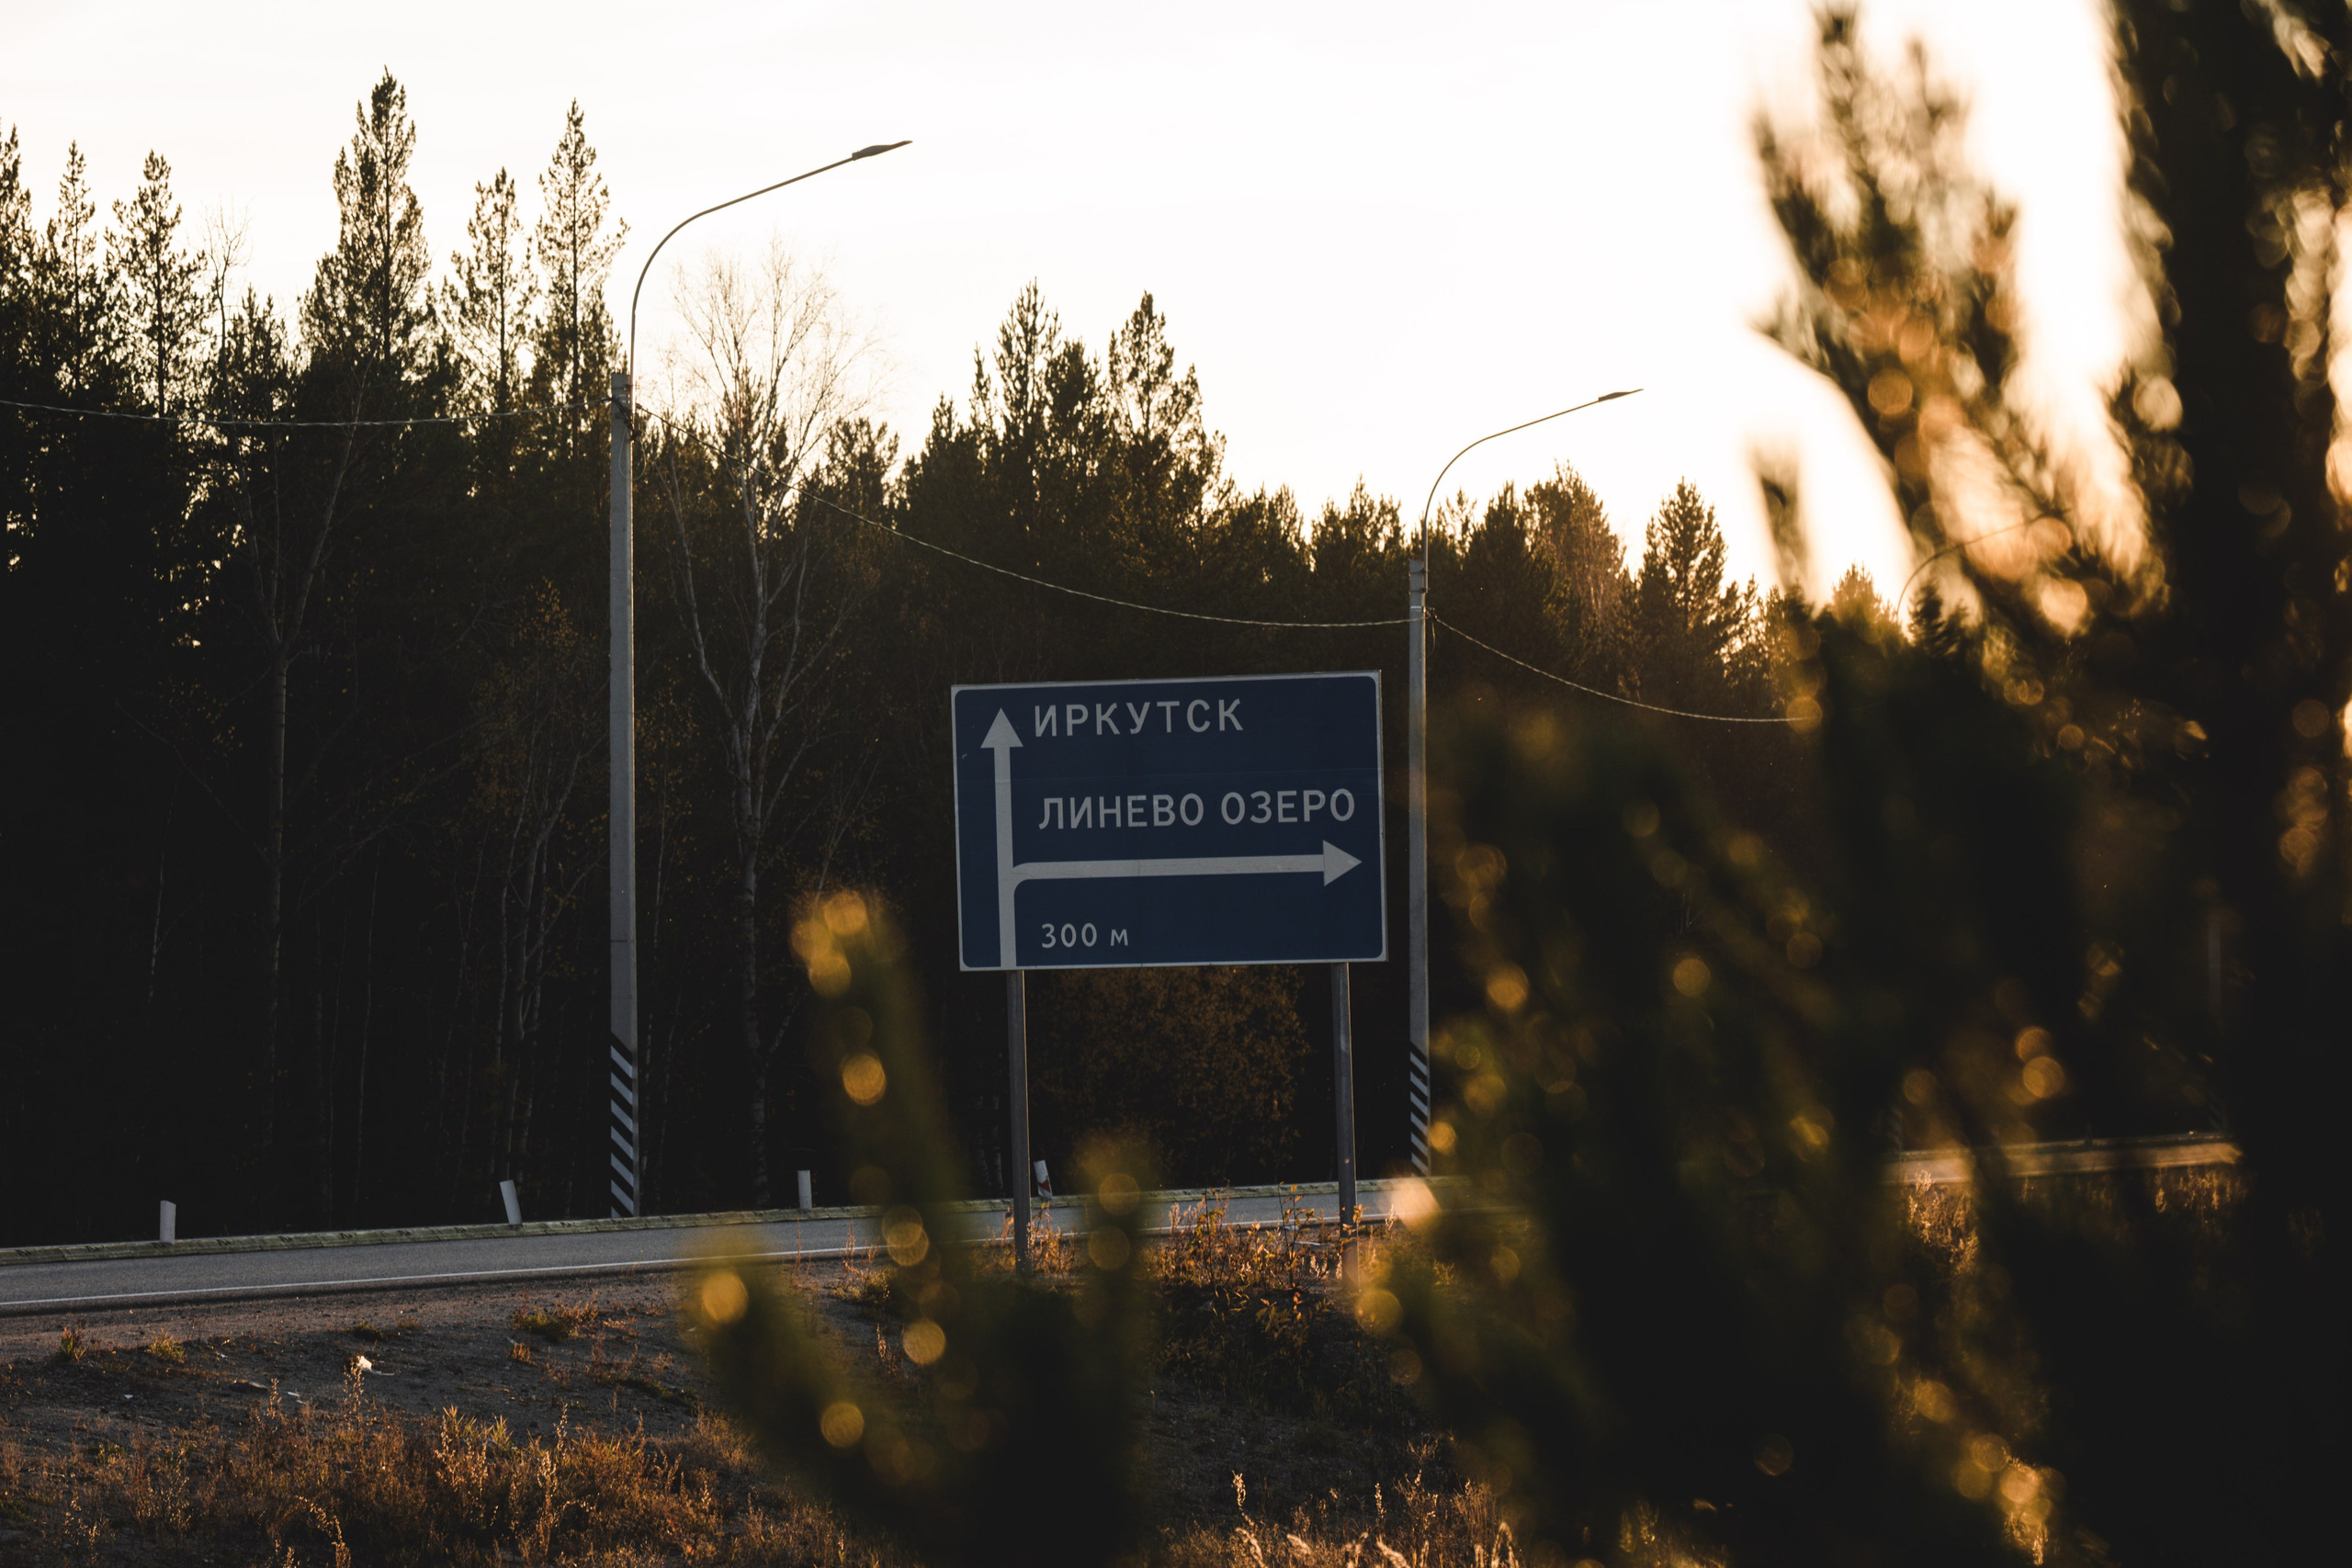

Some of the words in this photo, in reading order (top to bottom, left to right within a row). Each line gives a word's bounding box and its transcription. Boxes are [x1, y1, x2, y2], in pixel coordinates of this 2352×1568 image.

[1035, 698, 1243, 738] ИРКУТСК
[1038, 793, 1204, 829] ЛИНЕВО
[1220, 788, 1355, 825] ОЗЕРО
[1041, 922, 1098, 948] 300
